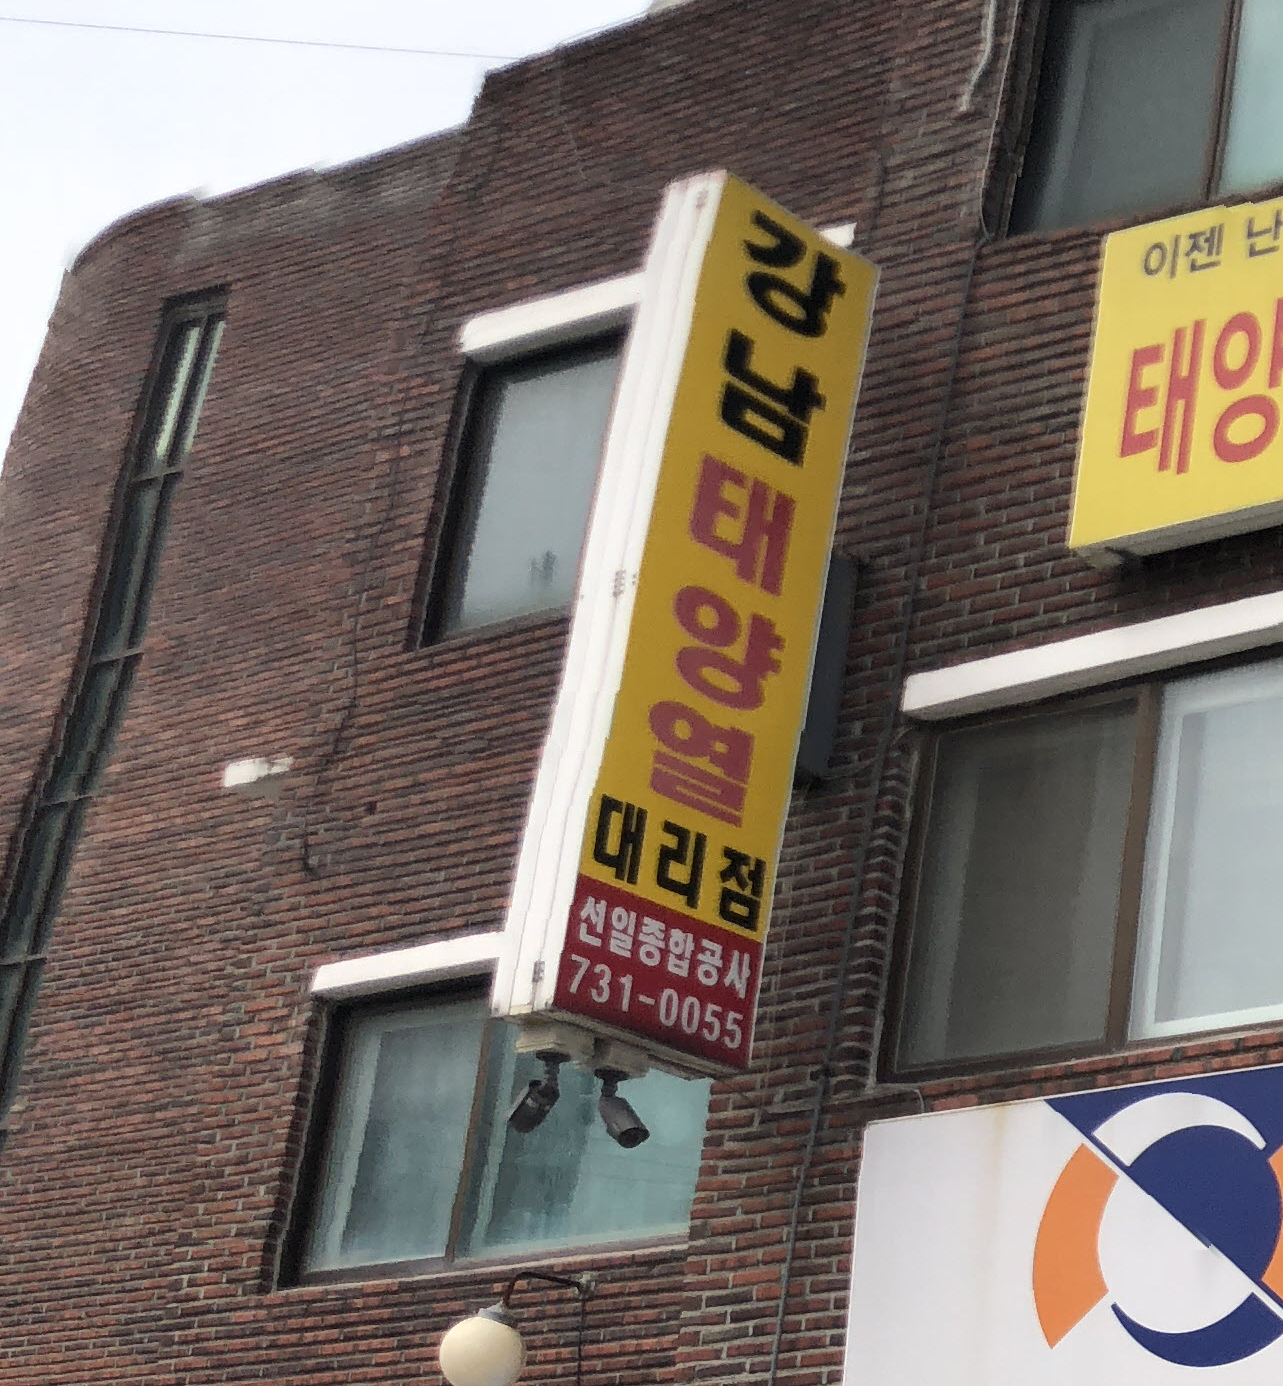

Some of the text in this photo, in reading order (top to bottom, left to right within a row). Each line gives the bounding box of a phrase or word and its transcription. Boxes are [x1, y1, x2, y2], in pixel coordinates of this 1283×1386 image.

[1142, 223, 1225, 280] 이젠
[592, 793, 768, 933] 대리점
[579, 895, 751, 1000] 선일종합공사
[568, 953, 744, 1050] 731-0055
